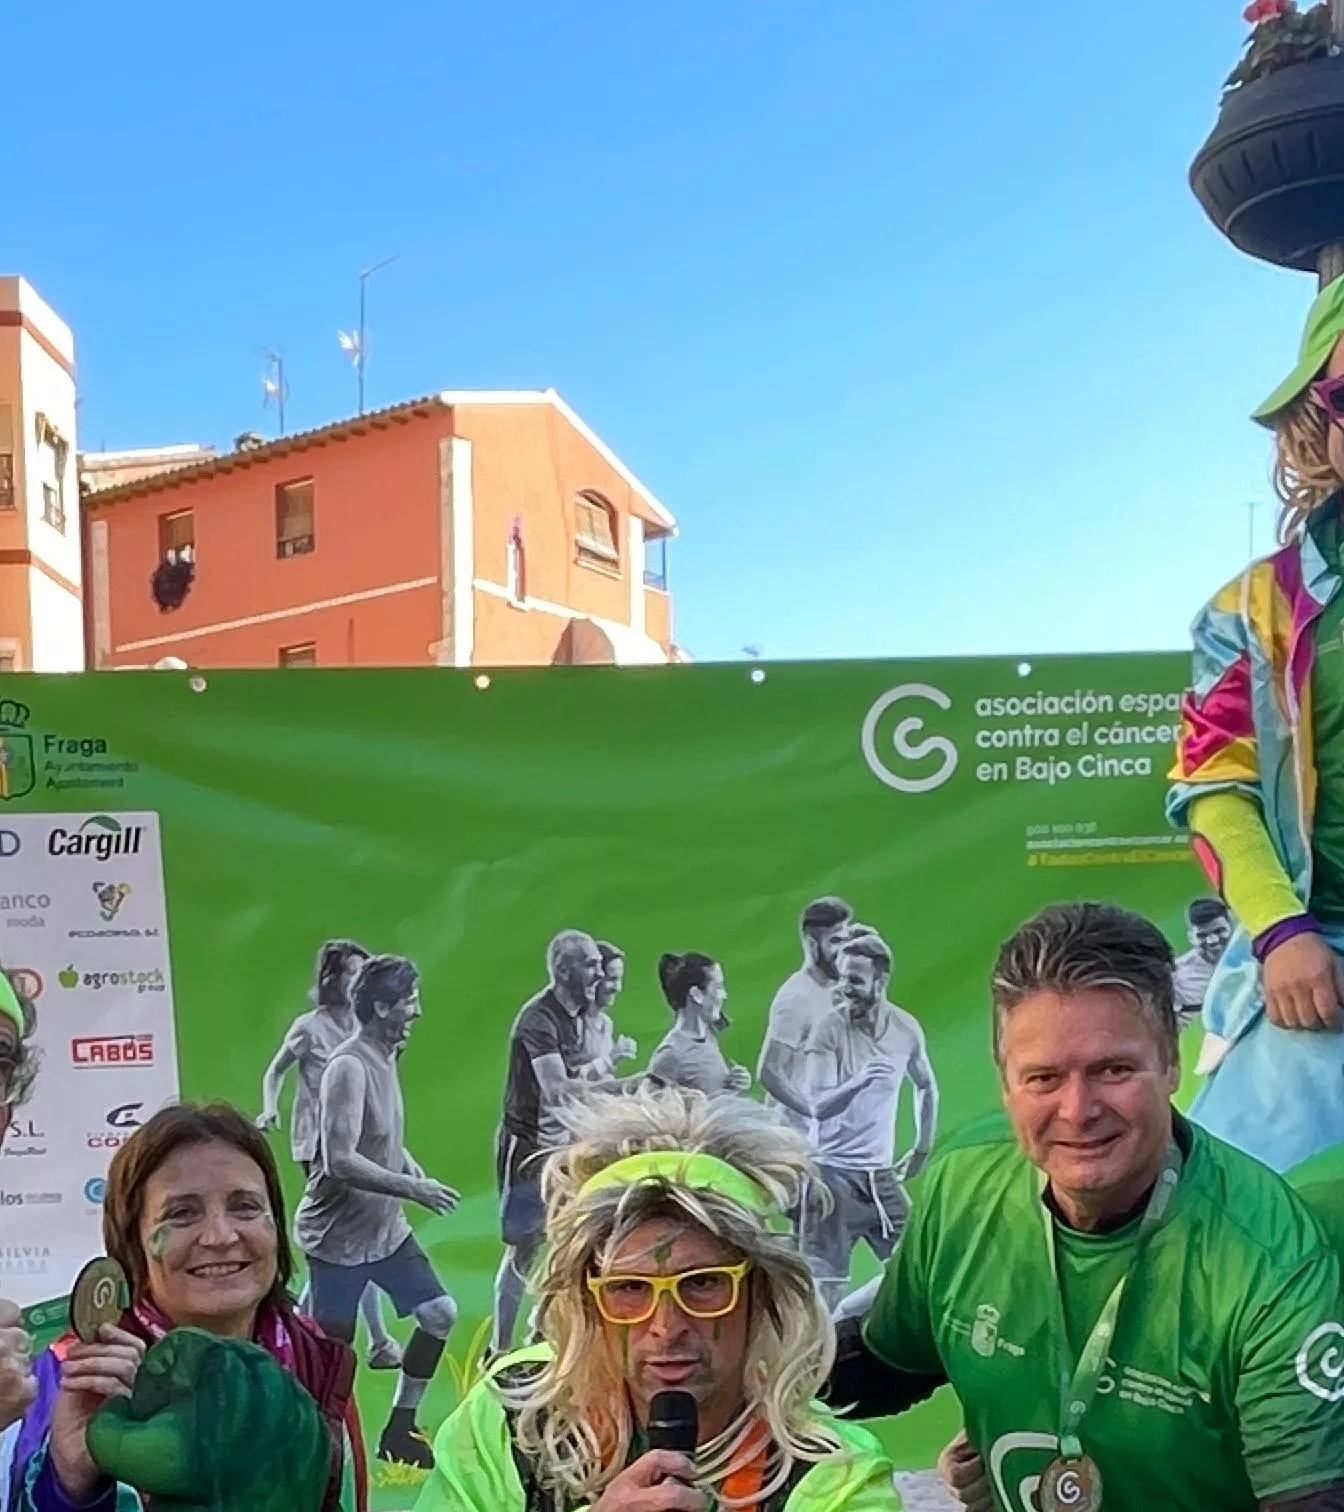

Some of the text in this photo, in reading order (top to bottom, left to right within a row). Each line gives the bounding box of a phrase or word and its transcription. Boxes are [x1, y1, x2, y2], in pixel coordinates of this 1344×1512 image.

[974, 690, 1182, 717] asociación espa
[44, 735, 108, 758] Fraga
[975, 720, 1182, 749] contra el cáncer
[975, 753, 1152, 785] en Bajo Cinca
[47, 826, 143, 862] Cargill
[6, 915, 46, 929] moda
[82, 967, 165, 990] agrostock
[9, 1119, 46, 1138] S.L.
